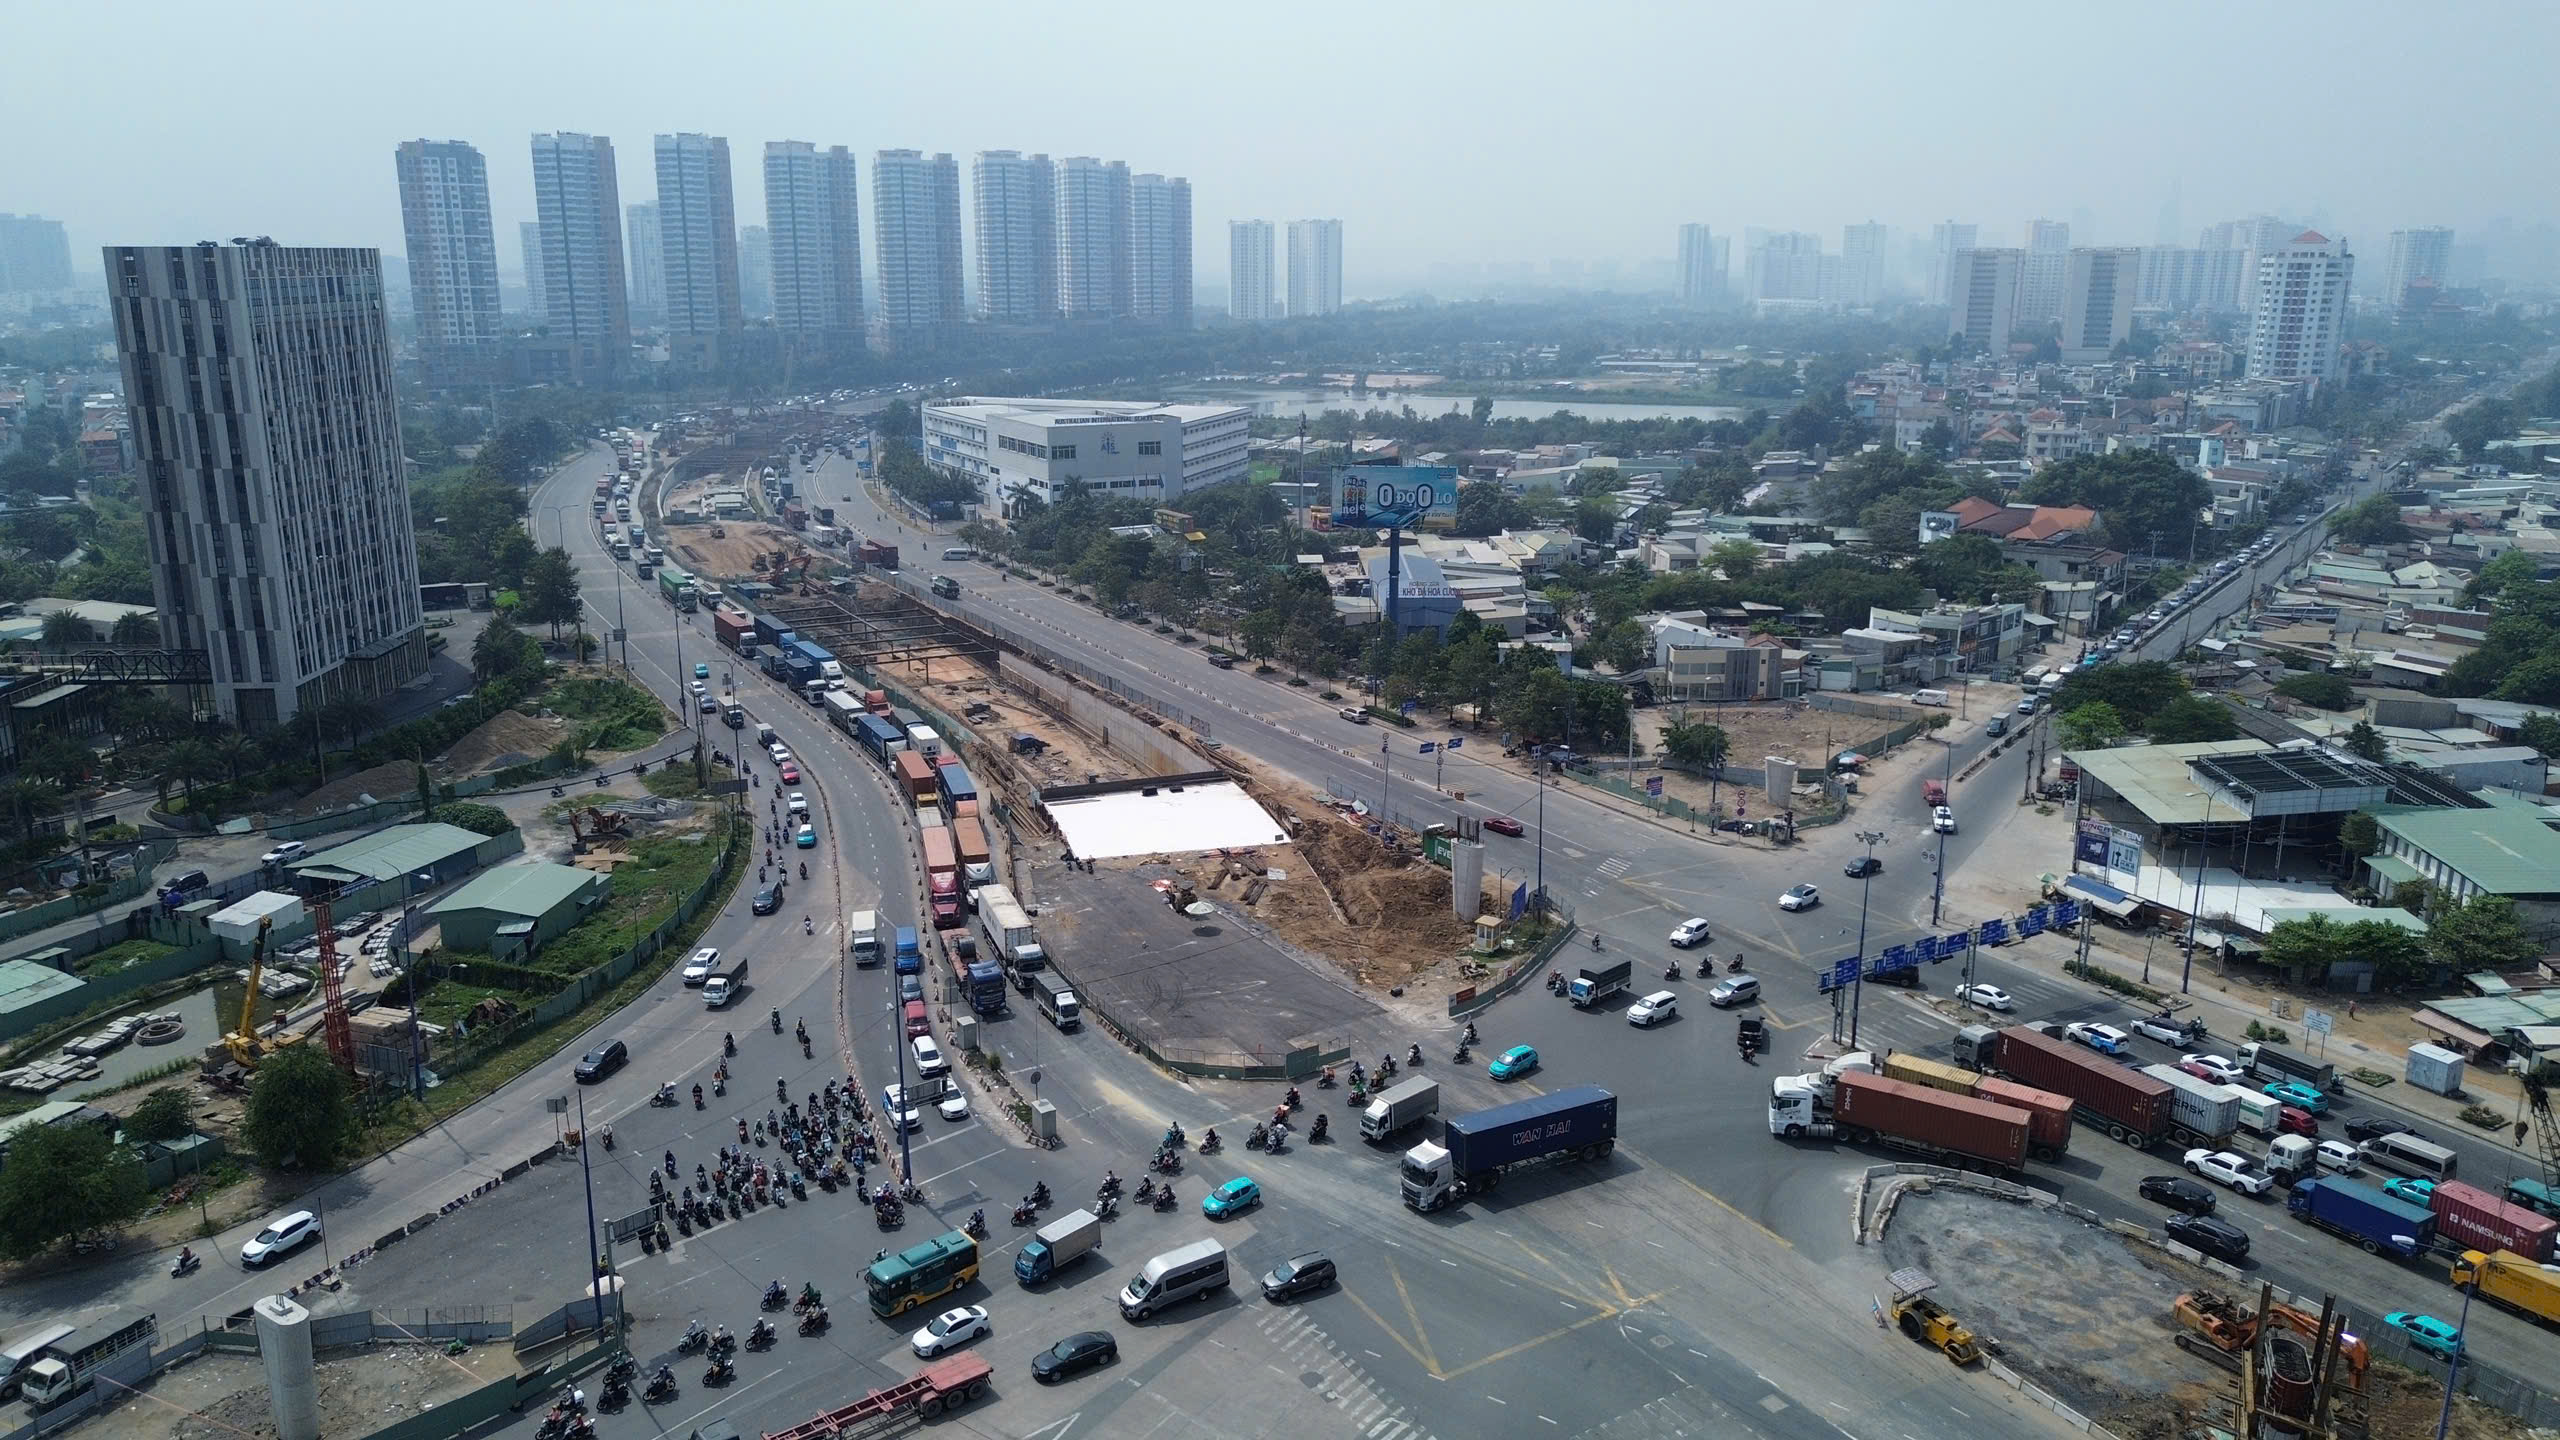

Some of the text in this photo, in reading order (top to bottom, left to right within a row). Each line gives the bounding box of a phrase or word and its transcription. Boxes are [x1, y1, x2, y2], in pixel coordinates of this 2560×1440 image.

[1403, 588, 1416, 596] KHO
[1513, 1120, 1571, 1146] WAN HAI
[2461, 1218, 2514, 1247] NAMSUNG
